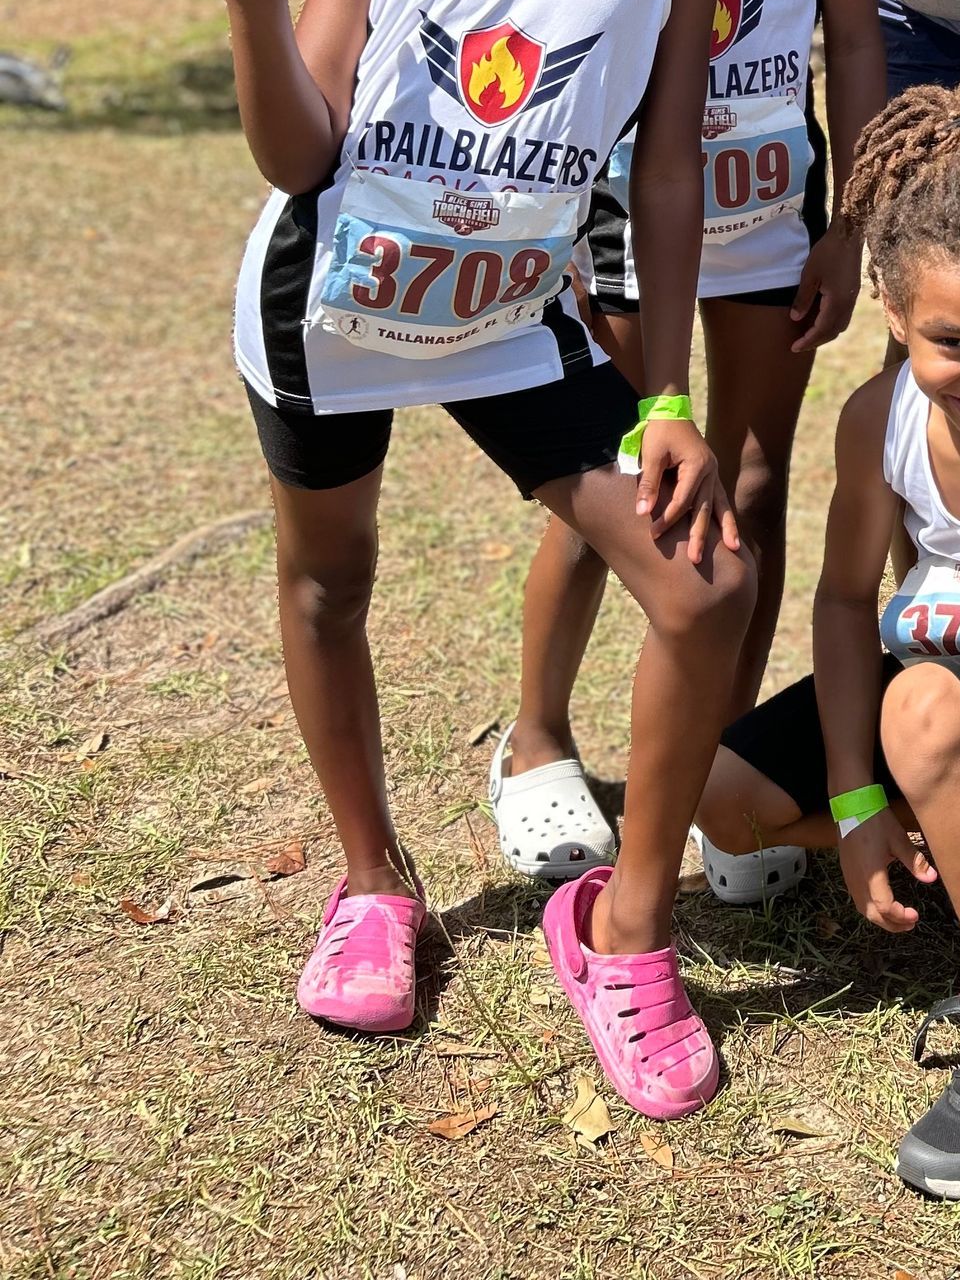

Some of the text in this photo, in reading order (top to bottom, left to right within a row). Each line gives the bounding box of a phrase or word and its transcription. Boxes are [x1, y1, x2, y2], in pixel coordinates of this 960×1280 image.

[709, 50, 800, 99] LAZERS
[703, 112, 736, 127] K&FIELD
[357, 121, 597, 187] TRAILBLAZERS
[701, 141, 790, 210] 09
[447, 195, 488, 209] ALICE SIMS
[703, 215, 764, 234] HASSEE, FL
[352, 235, 551, 320] 3708
[484, 317, 499, 329] FL
